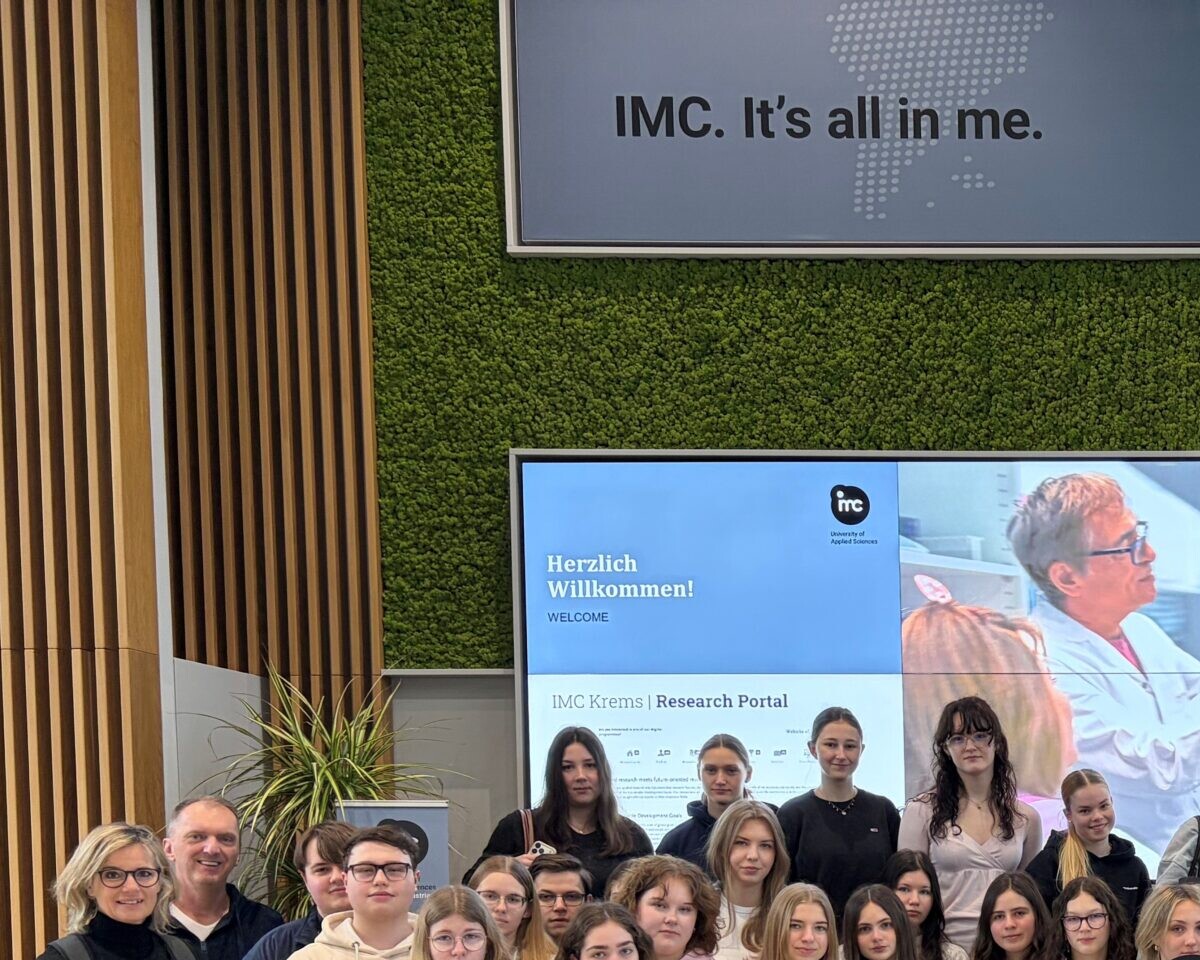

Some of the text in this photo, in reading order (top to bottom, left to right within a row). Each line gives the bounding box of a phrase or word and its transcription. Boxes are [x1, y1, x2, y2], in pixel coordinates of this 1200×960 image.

[615, 95, 725, 138] IMC.
[828, 96, 881, 139] all
[898, 97, 940, 139] in
[957, 107, 1043, 139] me.
[836, 490, 864, 512] imc
[547, 554, 638, 573] Herzlich
[547, 580, 694, 598] Willkommen!
[547, 612, 609, 622] WELCOME
[552, 694, 585, 709] IMC
[589, 694, 644, 709] Krems
[656, 694, 734, 708] Research
[738, 694, 789, 708] Portal
